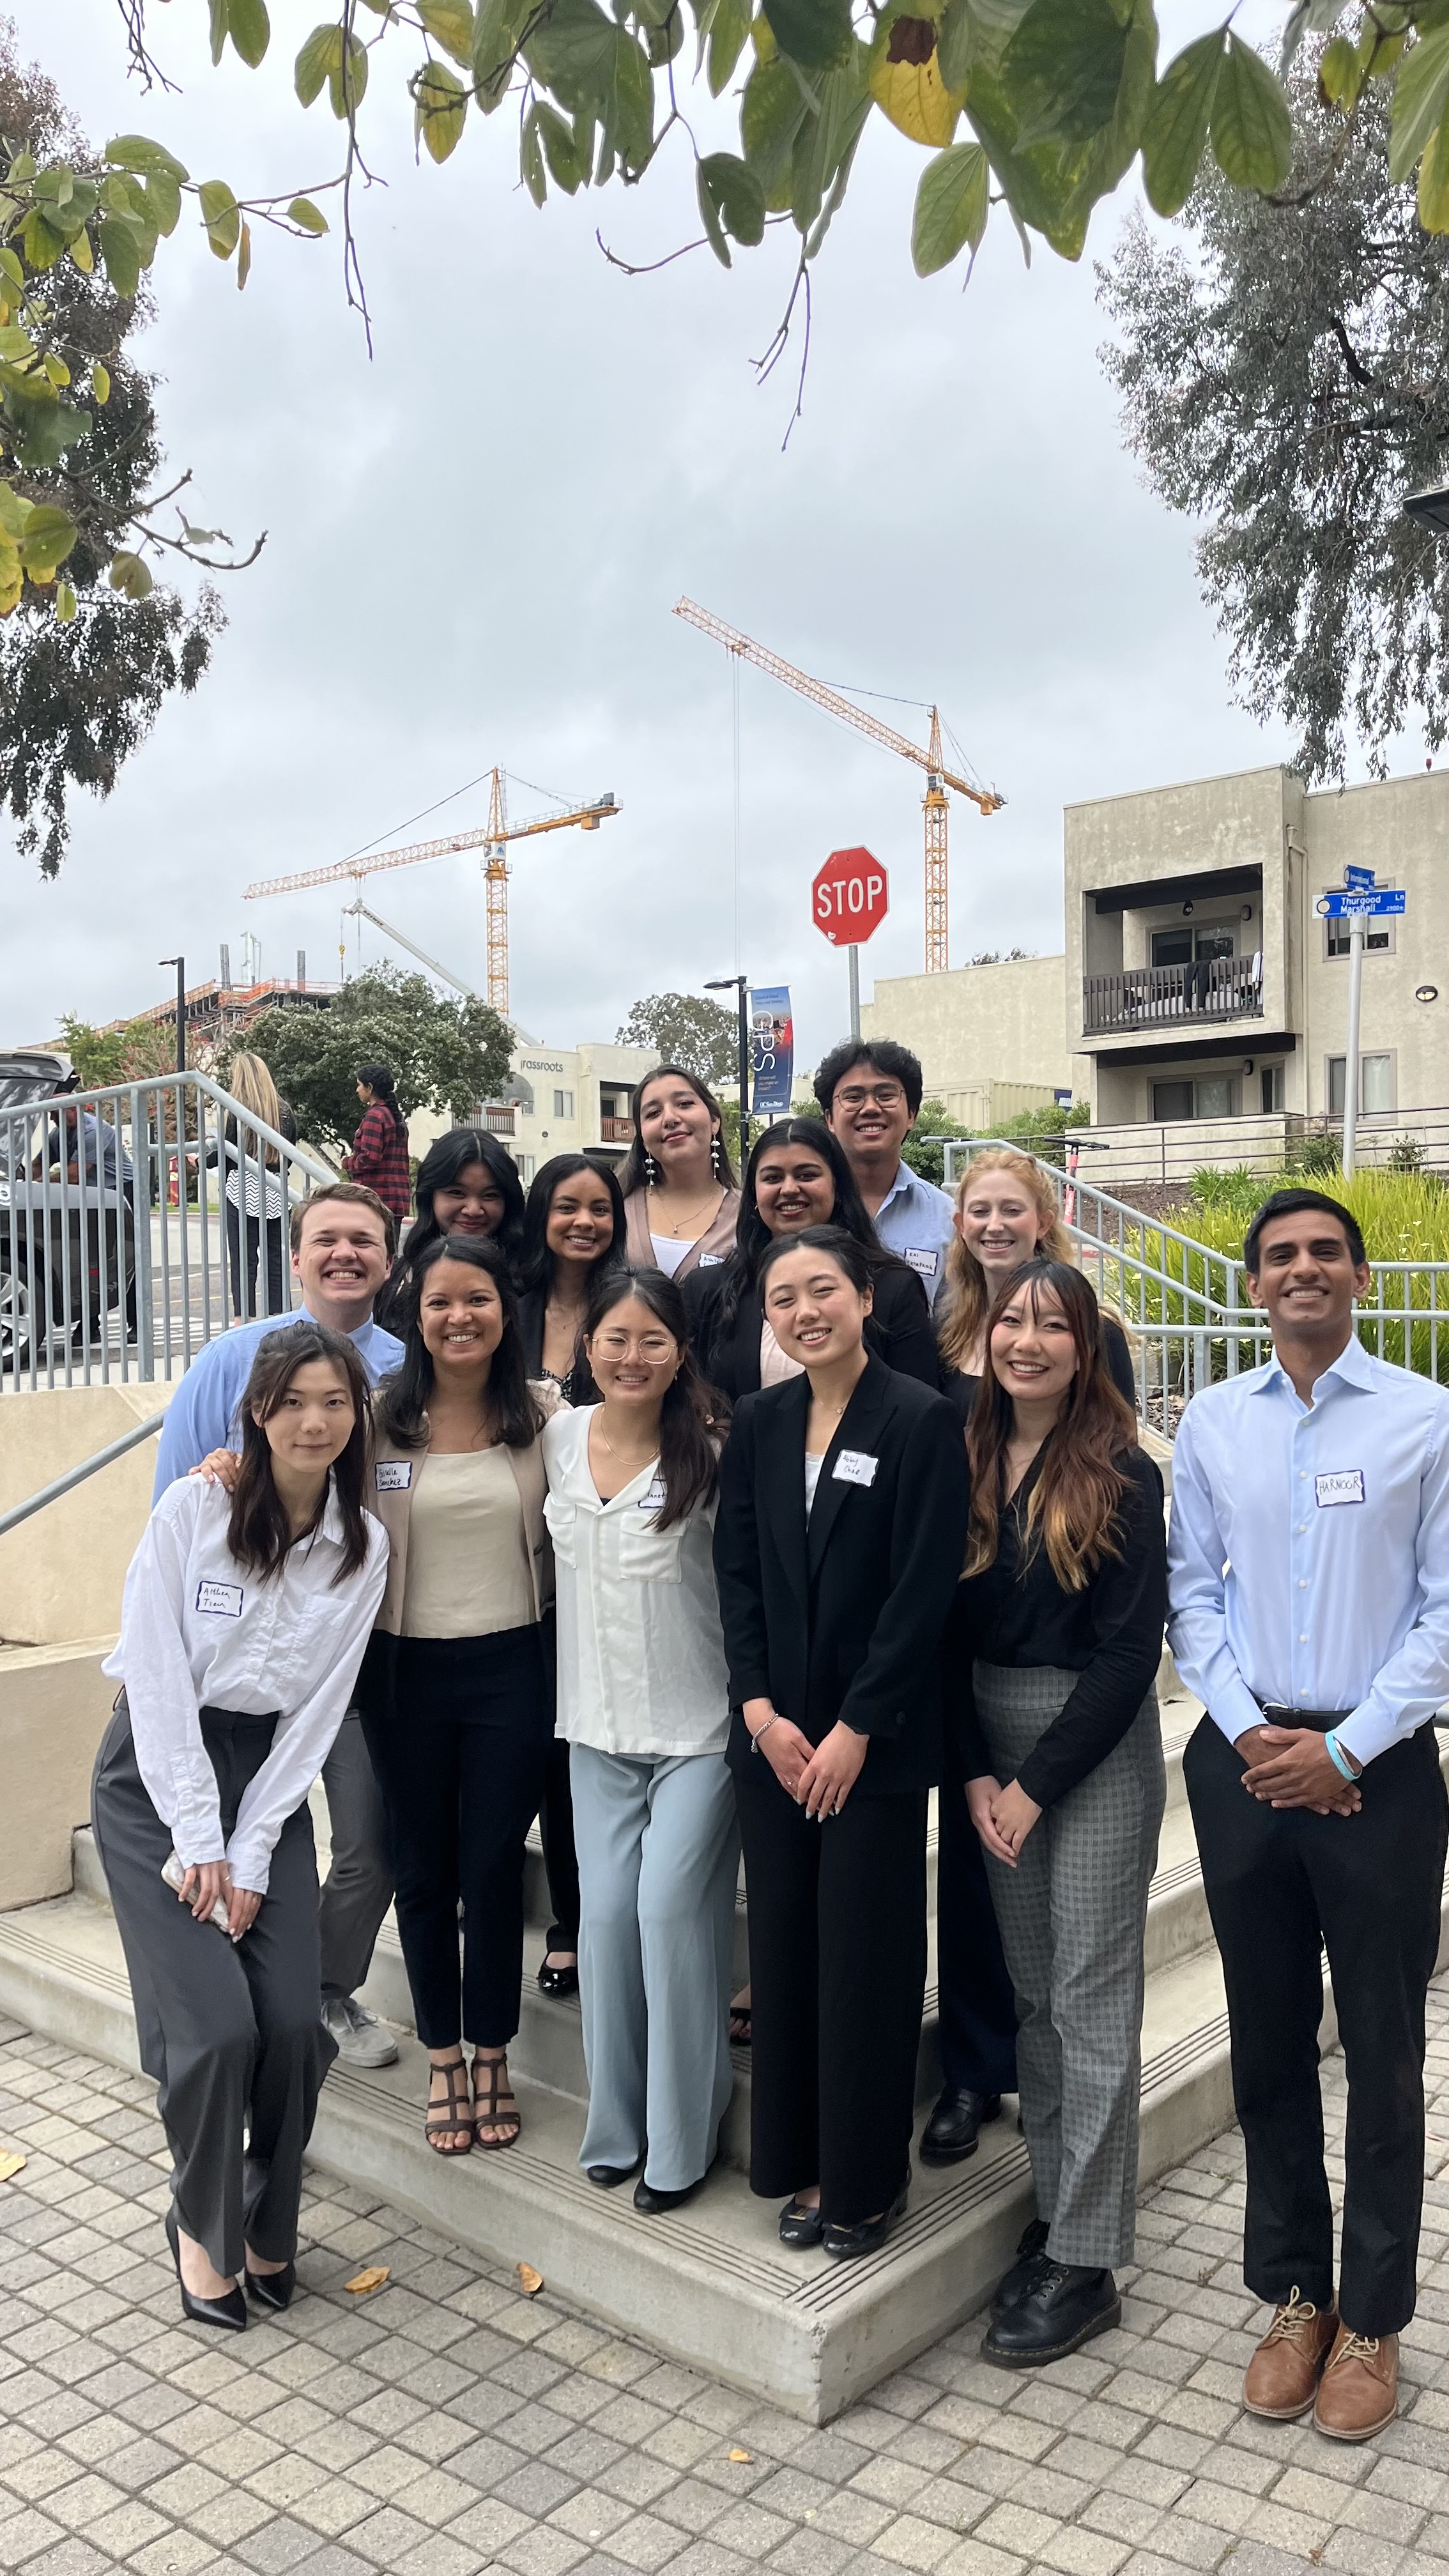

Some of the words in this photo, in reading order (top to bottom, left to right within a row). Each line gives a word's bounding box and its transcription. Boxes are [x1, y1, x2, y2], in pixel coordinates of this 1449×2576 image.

[817, 875, 883, 918] STOP
[1341, 894, 1381, 905] Thurgood
[1340, 903, 1376, 914] Marshall
[752, 1010, 776, 1071] GPS
[521, 1060, 564, 1072] rassroots
[379, 1467, 398, 1478] Giselle
[1319, 1476, 1361, 1496] HARNOOR
